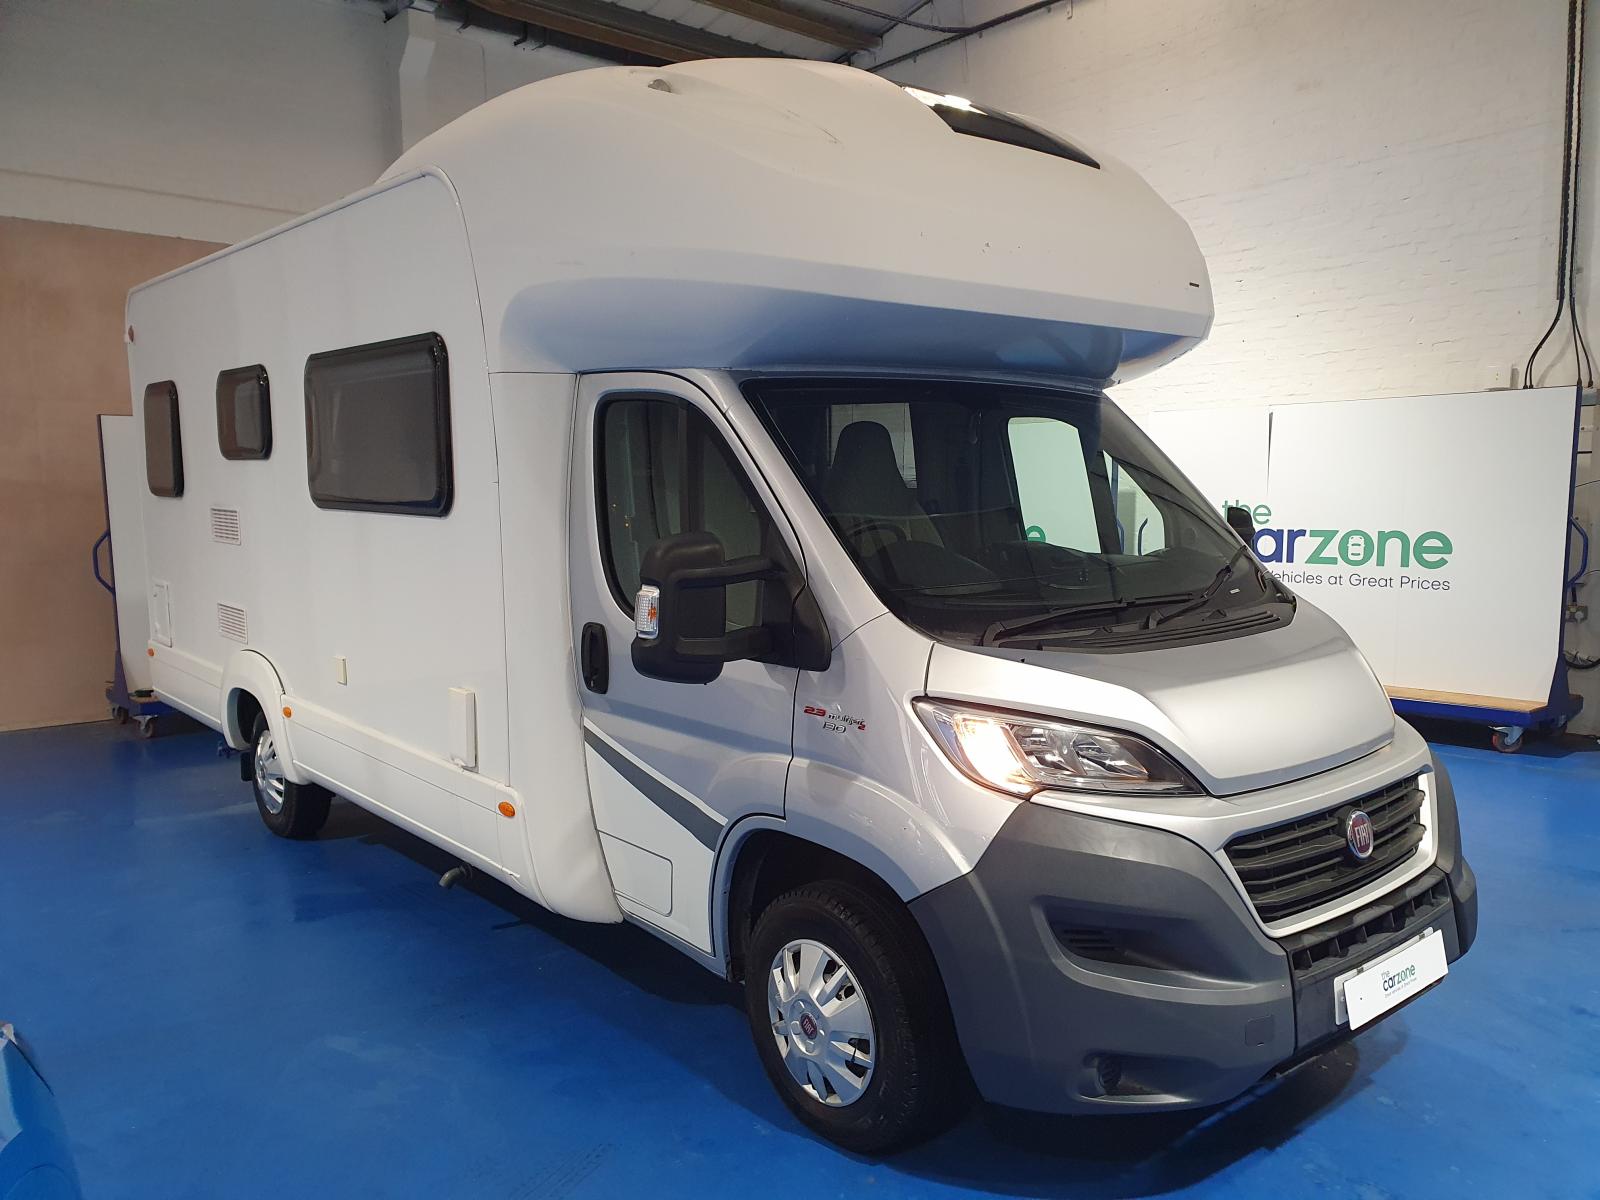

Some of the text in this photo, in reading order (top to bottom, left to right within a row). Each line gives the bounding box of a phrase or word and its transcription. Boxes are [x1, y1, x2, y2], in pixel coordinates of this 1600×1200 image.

[1253, 528, 1453, 570] arzone
[1271, 570, 1451, 591] ehicles at Great Prices
[1354, 822, 1371, 848] FIAT
[1383, 964, 1416, 991] carzone
